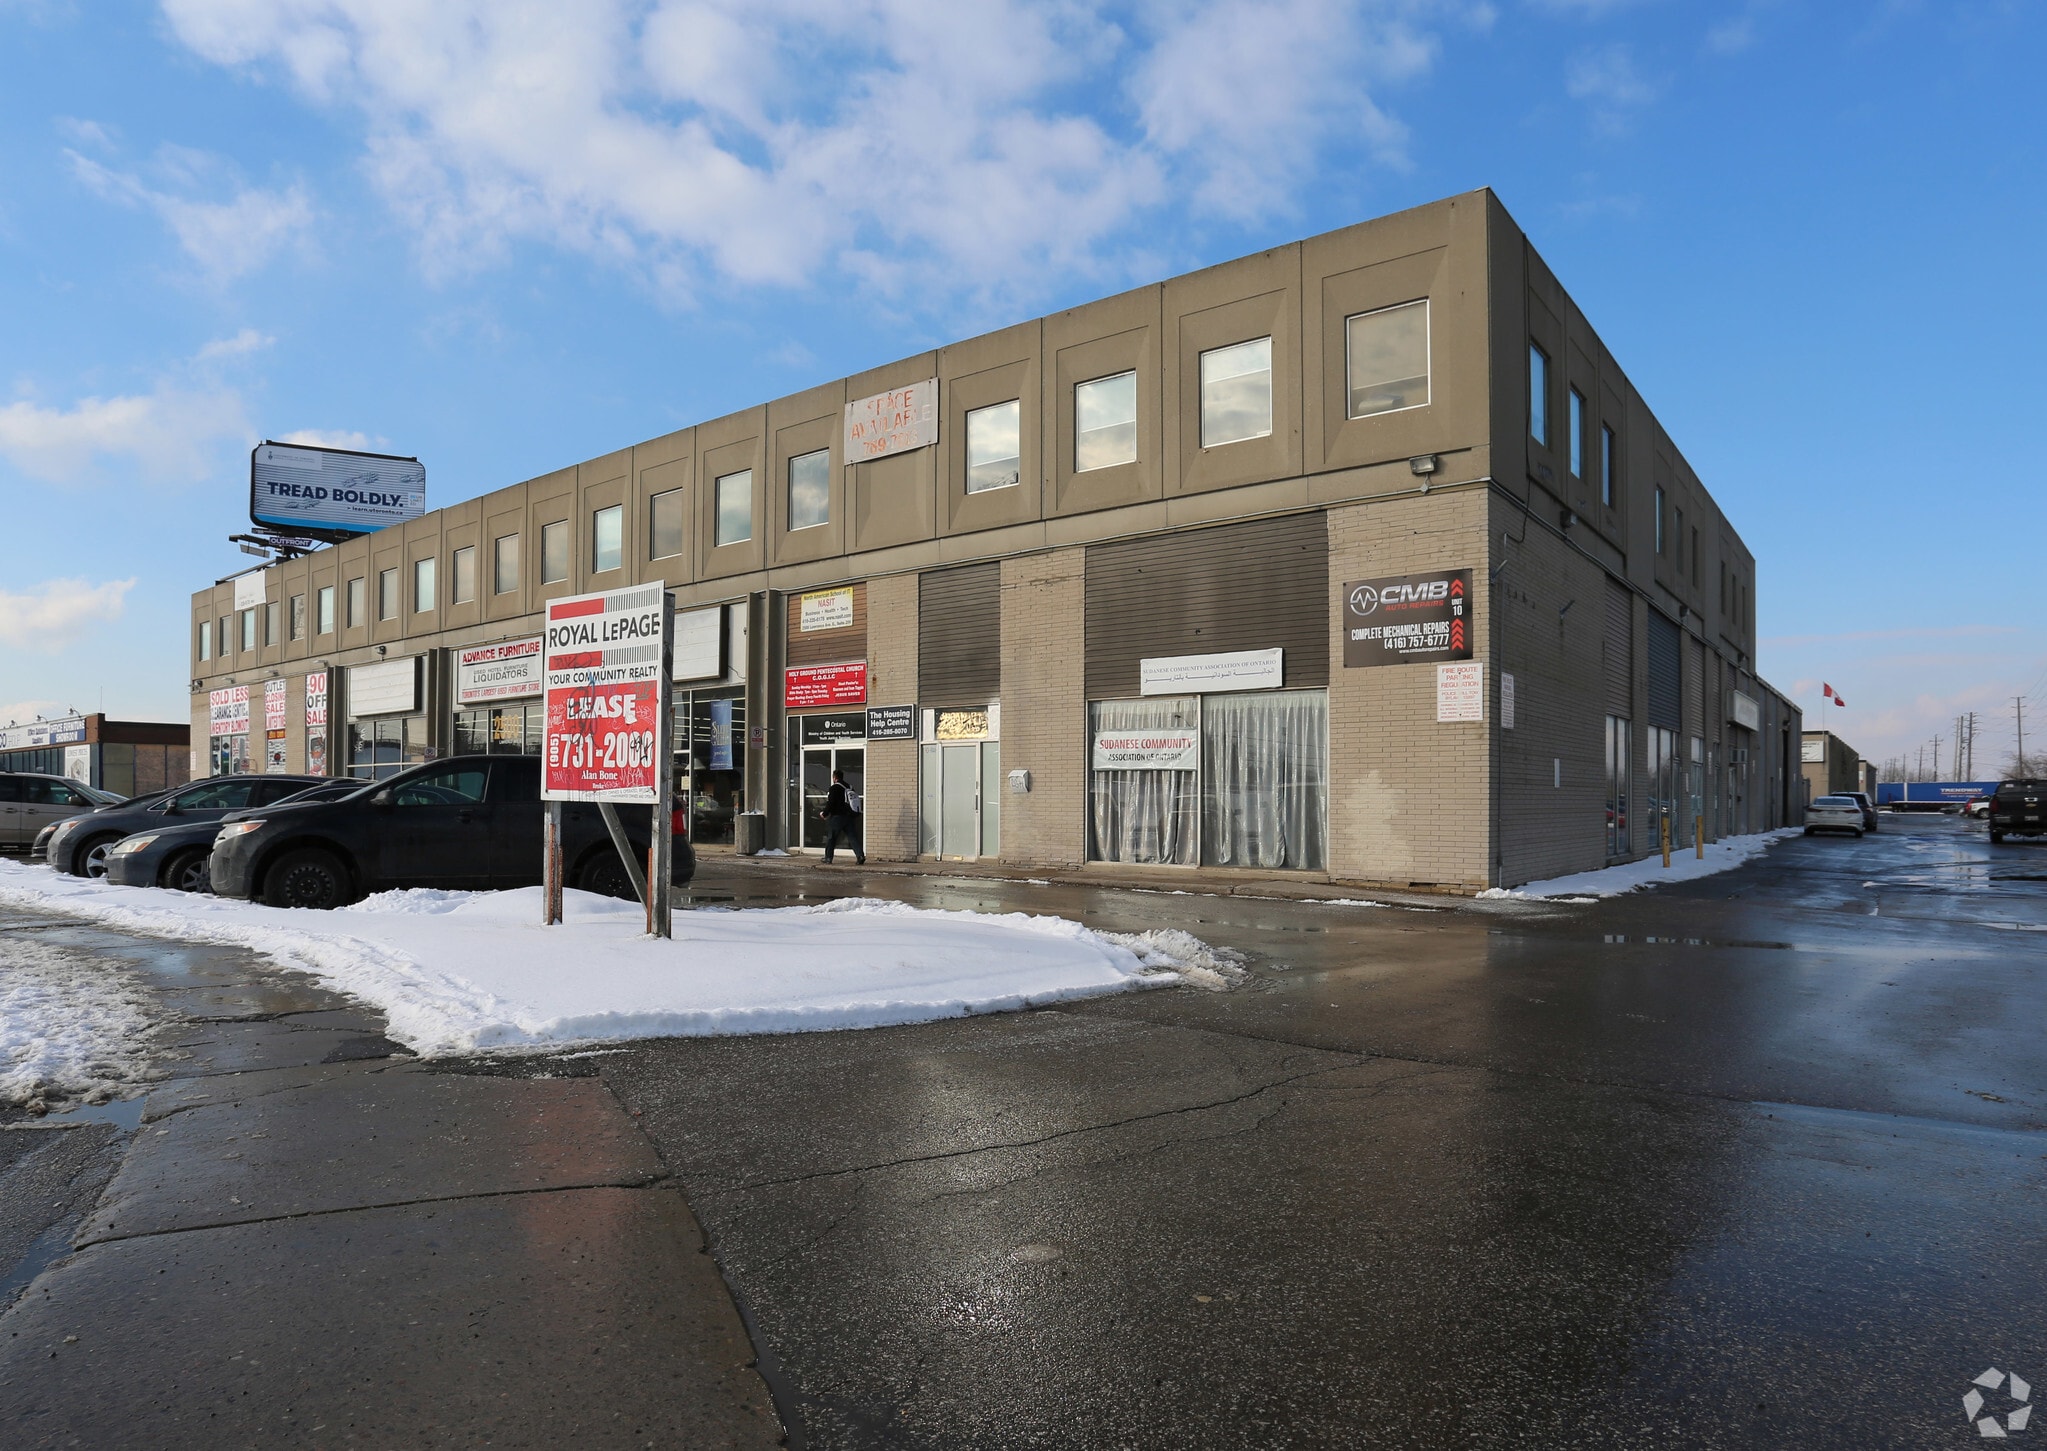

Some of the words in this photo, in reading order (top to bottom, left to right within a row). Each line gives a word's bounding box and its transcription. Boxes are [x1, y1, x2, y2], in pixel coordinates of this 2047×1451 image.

[267, 482, 328, 499] TREAD
[332, 489, 404, 507] BOLDLY.
[352, 506, 403, 515] learn.utoronto.ca
[271, 538, 311, 547] OUTFRONT
[1380, 580, 1448, 604] CMB
[818, 598, 835, 608] NASIT
[1386, 603, 1407, 611] AUTO
[1410, 600, 1444, 608] REPAIRS
[1453, 606, 1462, 615] 10
[550, 622, 597, 648] ROYAL
[1352, 627, 1382, 640] COMPLETE
[1383, 624, 1422, 638] MECHANICAL
[1423, 621, 1449, 634] REPAIRS
[1384, 638, 1406, 649] (416)
[1409, 634, 1449, 648] 757-6777
[462, 649, 495, 663] ADVANCE
[498, 641, 540, 657] FURNITURE
[1203, 662, 1240, 670] ASSOCIATION
[474, 668, 528, 683] LIQUIDATORS
[549, 674, 570, 685] YOUR
[573, 669, 626, 683] COMMUNITY
[630, 665, 657, 678] REALTY
[266, 680, 285, 692] OUTLET
[310, 674, 325, 694] 90
[462, 690, 480, 698] TORONTO'S
[481, 688, 496, 696] LARGEST
[497, 687, 507, 695] USED
[508, 685, 527, 694] FURNITURE
[528, 683, 540, 691] STORE
[212, 692, 229, 706] SOLD
[232, 687, 248, 702] LESS
[308, 695, 326, 708] OFF
[266, 703, 283, 713] SALE
[567, 694, 636, 720] LEASE
[884, 710, 910, 718] Housing
[307, 710, 327, 725] SALE
[870, 720, 886, 728] Help
[64, 719, 85, 731] FURNITURE
[550, 734, 559, 767] (905)
[1100, 739, 1139, 749] SUDANESE
[1141, 738, 1192, 748] COMMUNITY
[582, 770, 597, 780] Alan
[599, 770, 618, 779] Bone
